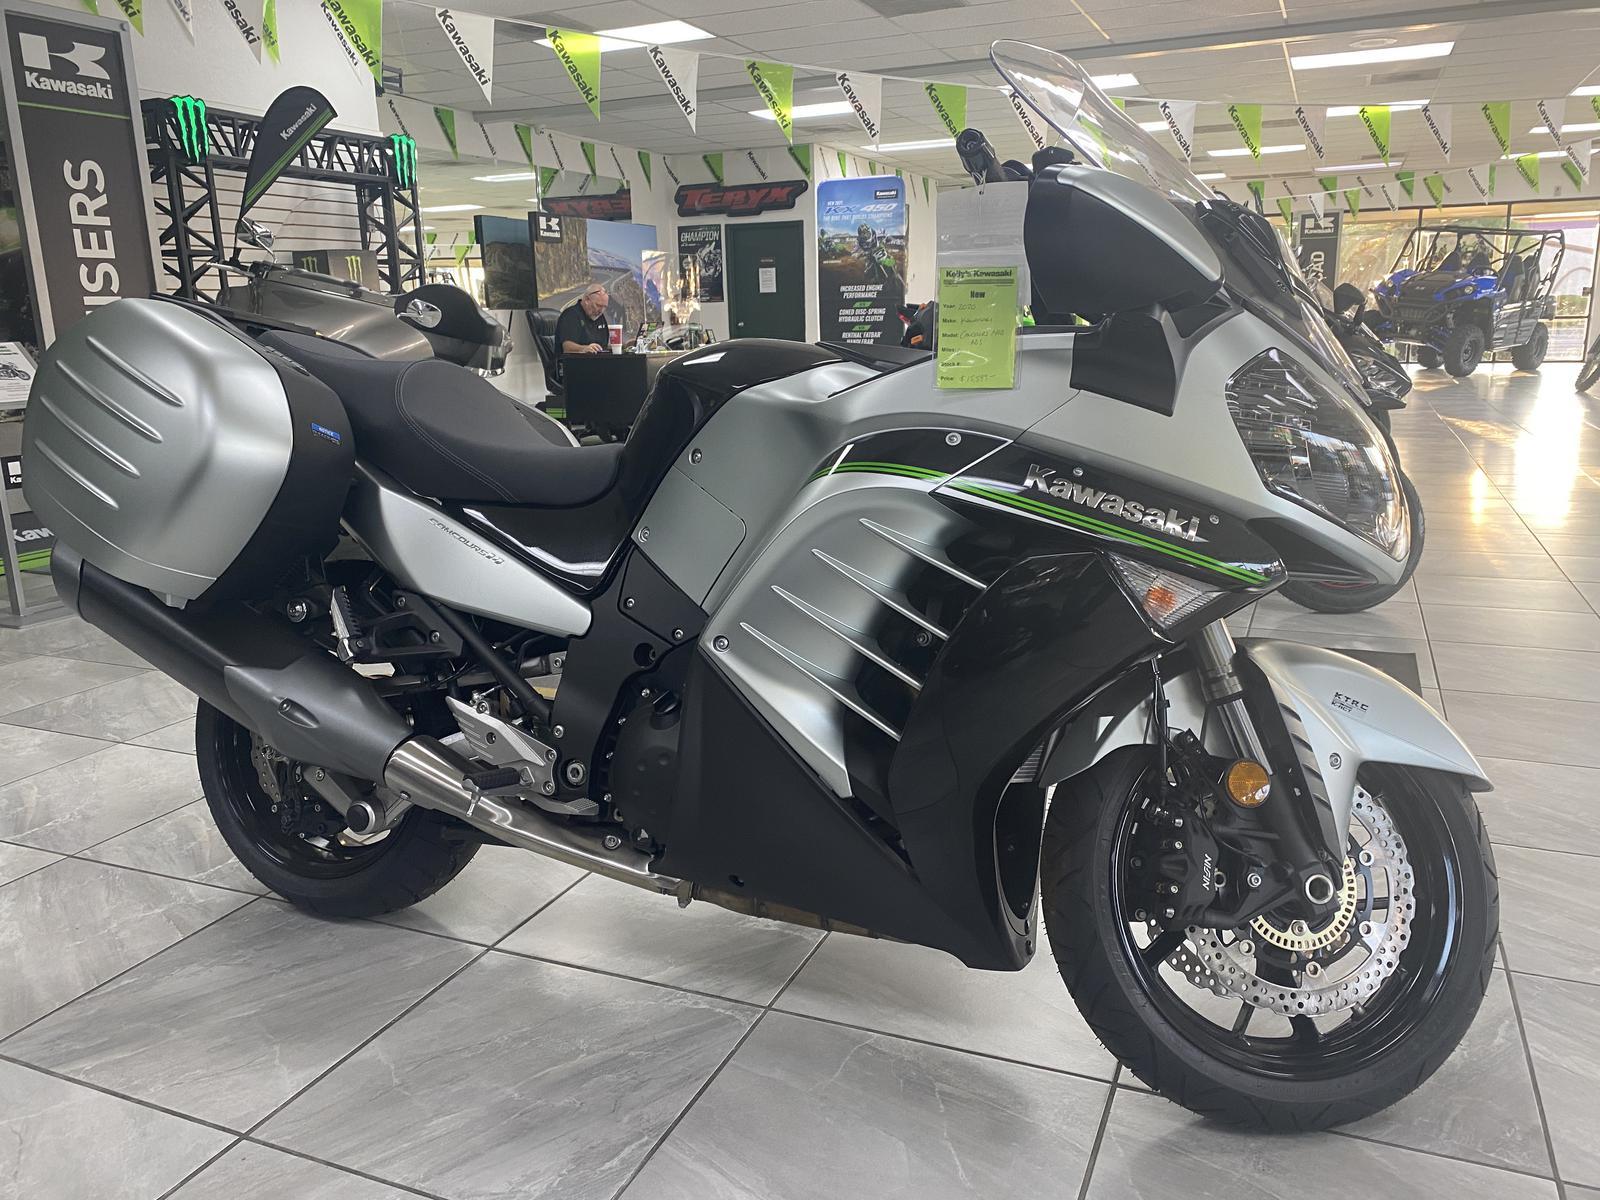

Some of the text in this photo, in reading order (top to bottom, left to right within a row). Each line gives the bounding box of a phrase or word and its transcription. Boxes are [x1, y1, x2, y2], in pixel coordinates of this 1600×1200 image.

[224, 0, 261, 45] asaki
[320, 1, 359, 66] Kawasaki
[326, 0, 380, 67] awasaki
[437, 9, 492, 87] Kawasaki
[24, 71, 114, 100] Kawasaki
[548, 30, 599, 104] Kawasaki
[649, 45, 696, 117] Kawasaki
[746, 61, 791, 130] Kawasaki
[837, 72, 879, 139] Kawasaki
[924, 83, 961, 138] Kawasa
[280, 103, 317, 141] Kawasaki
[1160, 101, 1192, 158] Kawasaki
[1228, 105, 1260, 160] Kawasaki
[1295, 107, 1325, 160] Kawasaki
[1359, 107, 1389, 158] Kawasaki
[1421, 105, 1450, 156] Kawasaki
[1481, 103, 1509, 152] Kawasaki
[1537, 100, 1561, 147] Kawasak
[1467, 167, 1487, 197] Kawasaki
[1515, 158, 1538, 189] Kawasaki
[1566, 145, 1588, 177] Kawasaki
[62, 158, 123, 306] ISERS
[861, 203, 898, 212] 450
[681, 231, 720, 242] CHAMPION
[843, 291, 877, 299] PERFORMANCE
[970, 290, 985, 298] New
[973, 269, 1012, 277] Kawasaki
[1022, 463, 1201, 542] Kawasaki
[1334, 691, 1369, 712] KTRC
